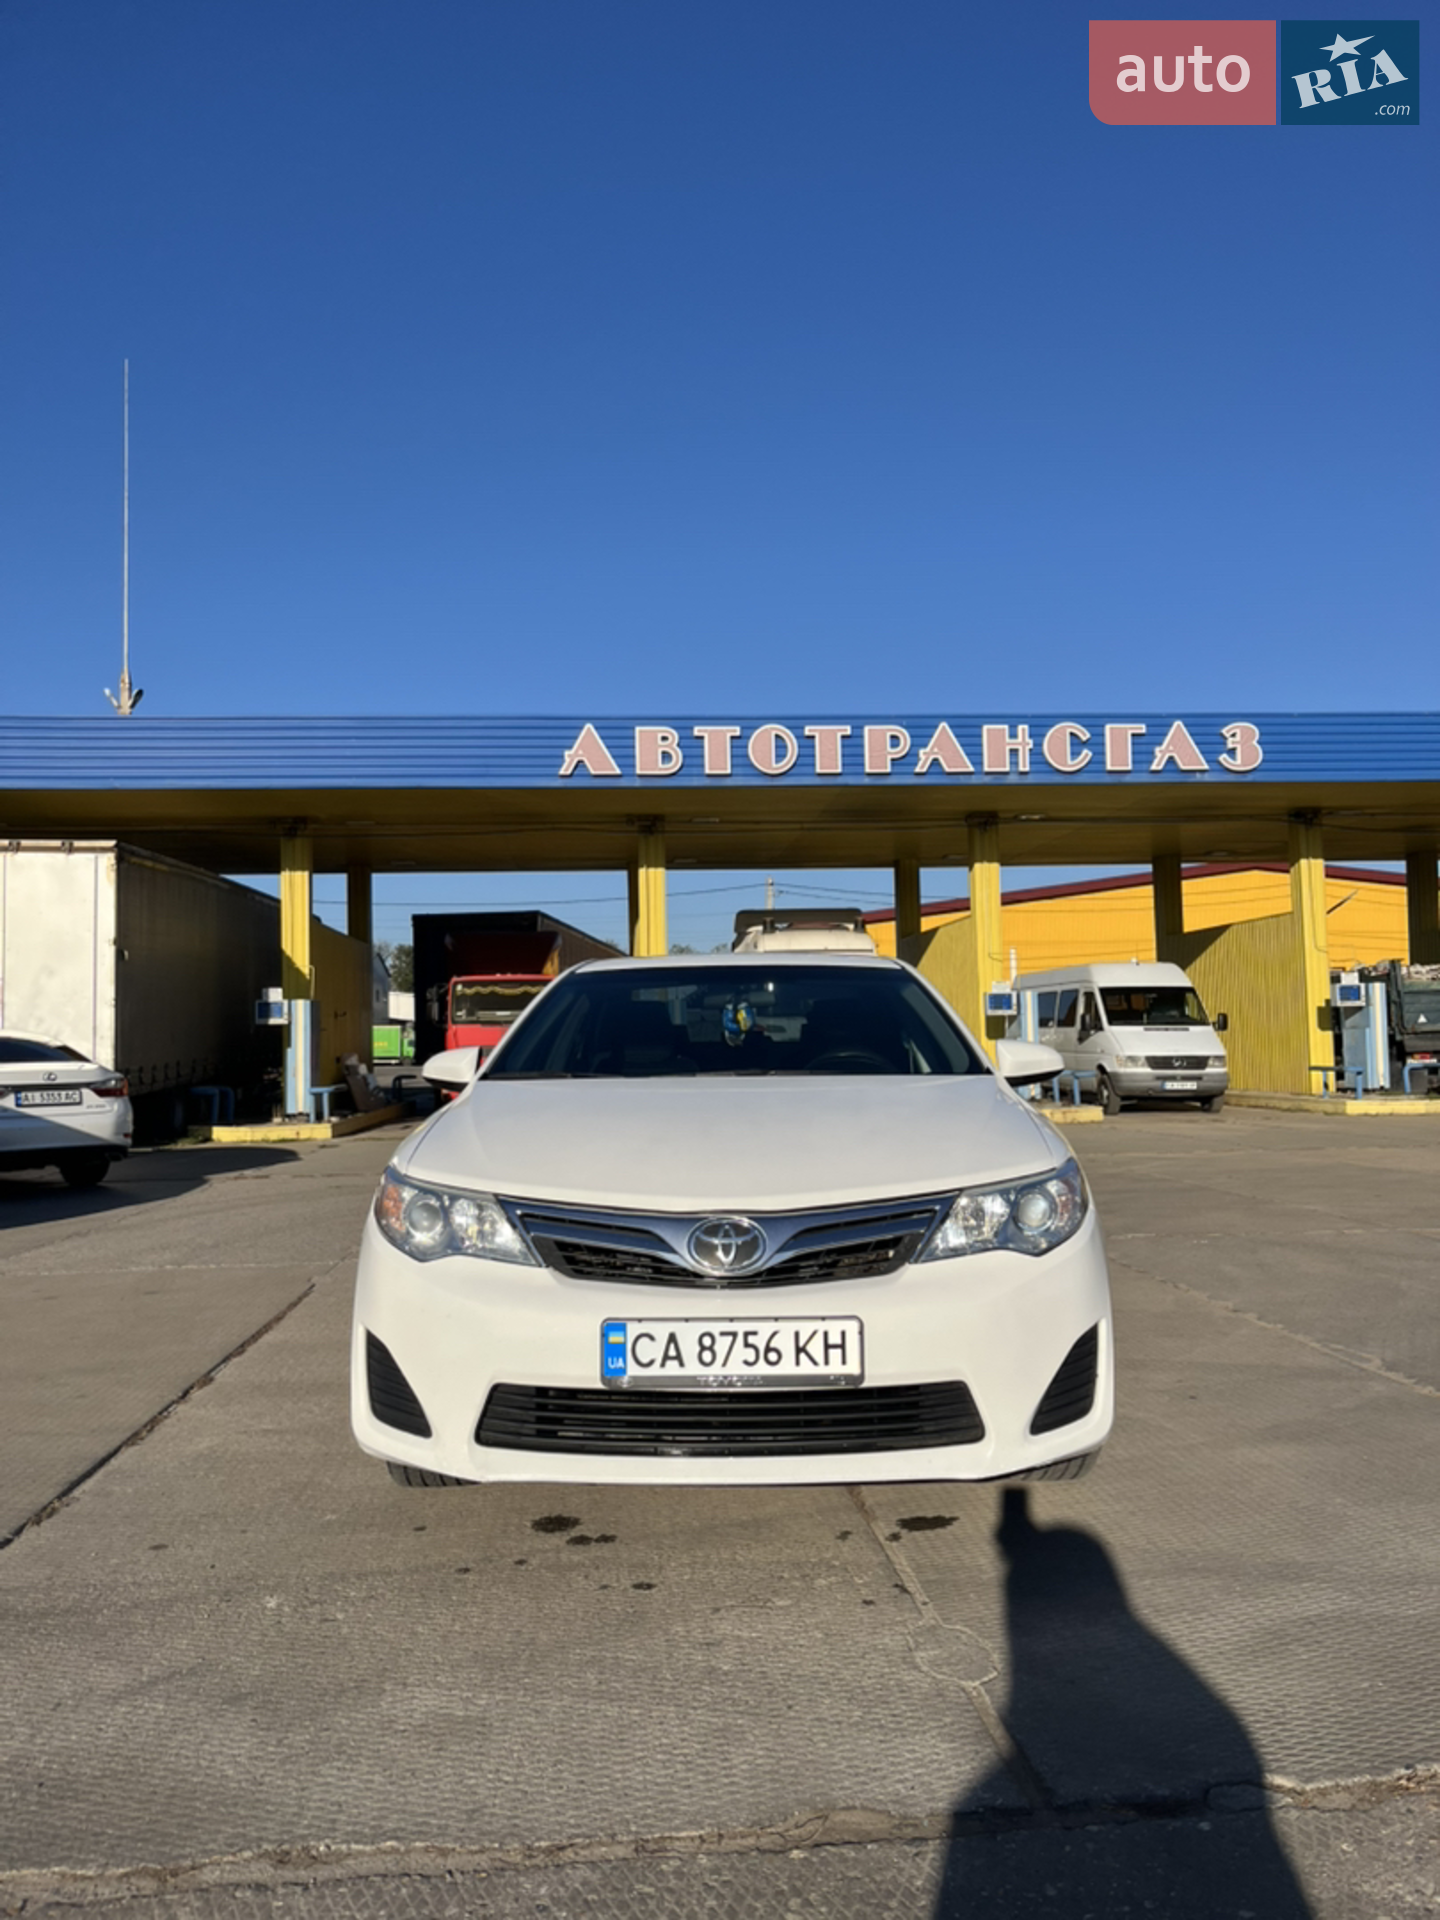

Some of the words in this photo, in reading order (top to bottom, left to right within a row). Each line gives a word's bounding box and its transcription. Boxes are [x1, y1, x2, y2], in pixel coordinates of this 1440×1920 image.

[558, 720, 1264, 777] АВТОТРАНСГАЗ
[607, 1356, 625, 1369] UA
[631, 1331, 685, 1368] CA
[697, 1330, 783, 1368] 8756
[794, 1329, 847, 1367] KH
